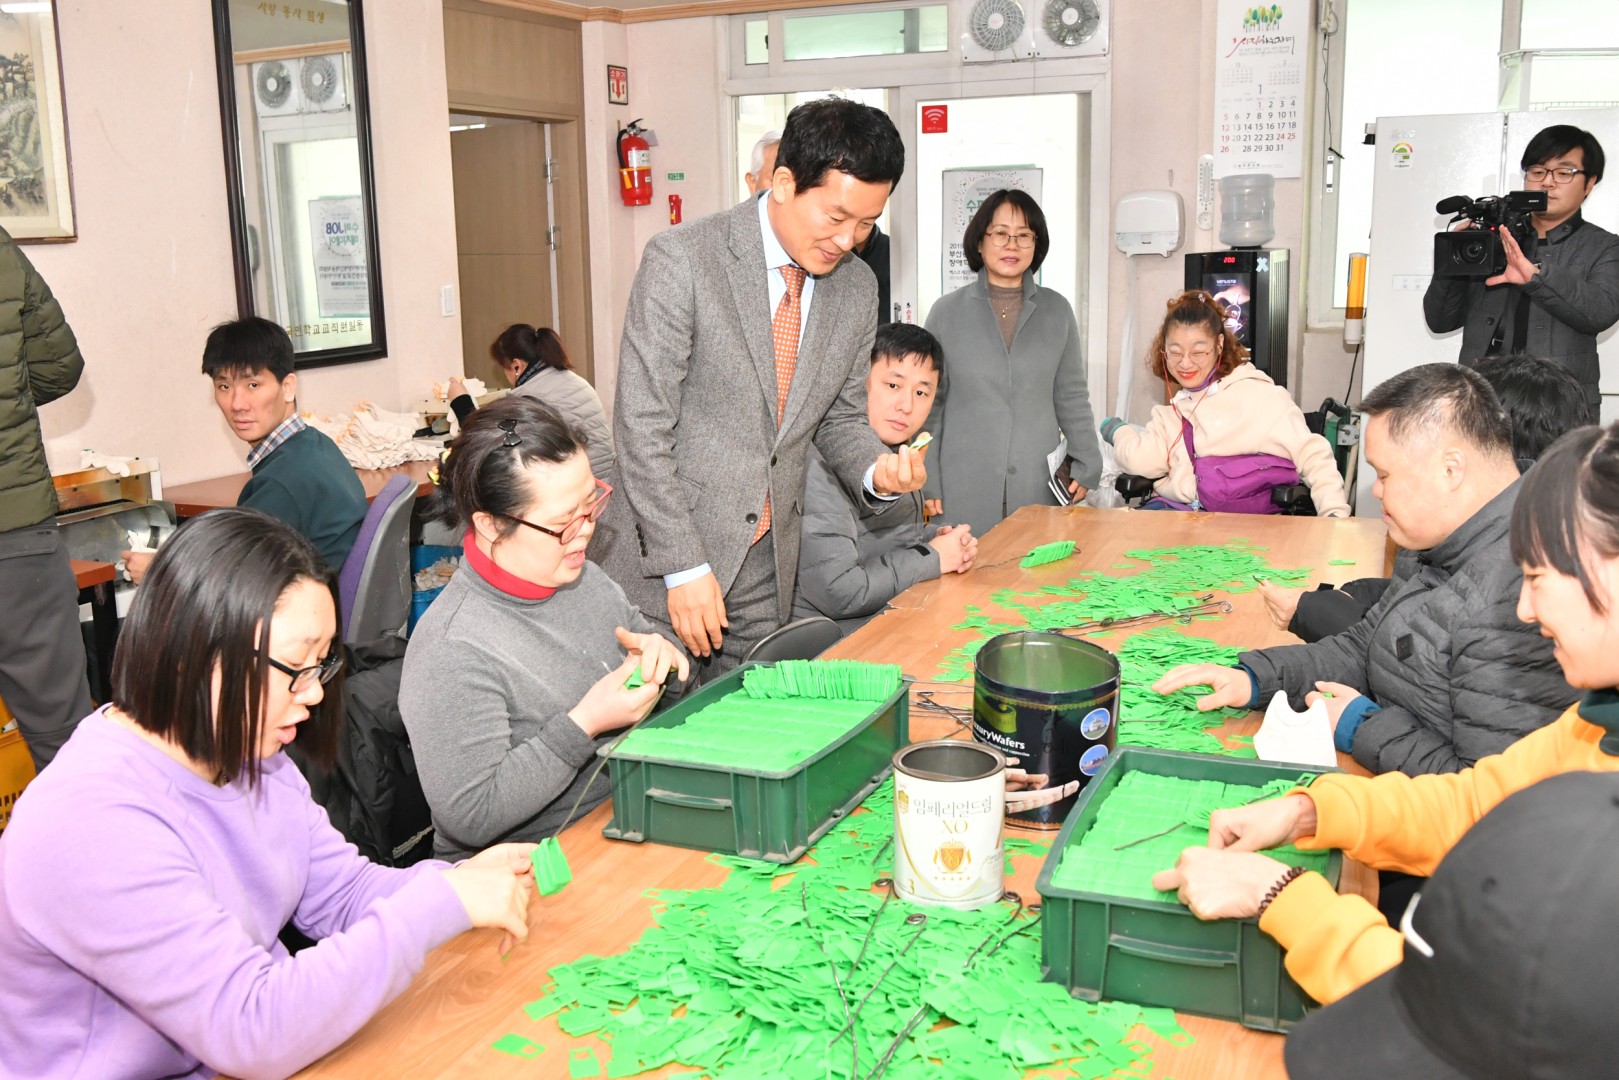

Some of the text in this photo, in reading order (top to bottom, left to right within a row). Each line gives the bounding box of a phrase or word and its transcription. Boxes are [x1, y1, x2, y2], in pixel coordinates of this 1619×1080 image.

[257, 2, 325, 24] 사랑 봉사 희생
[1258, 84, 1262, 95] 1
[1280, 100, 1284, 108] 3
[941, 820, 968, 834] XO
[908, 879, 915, 896] 3
